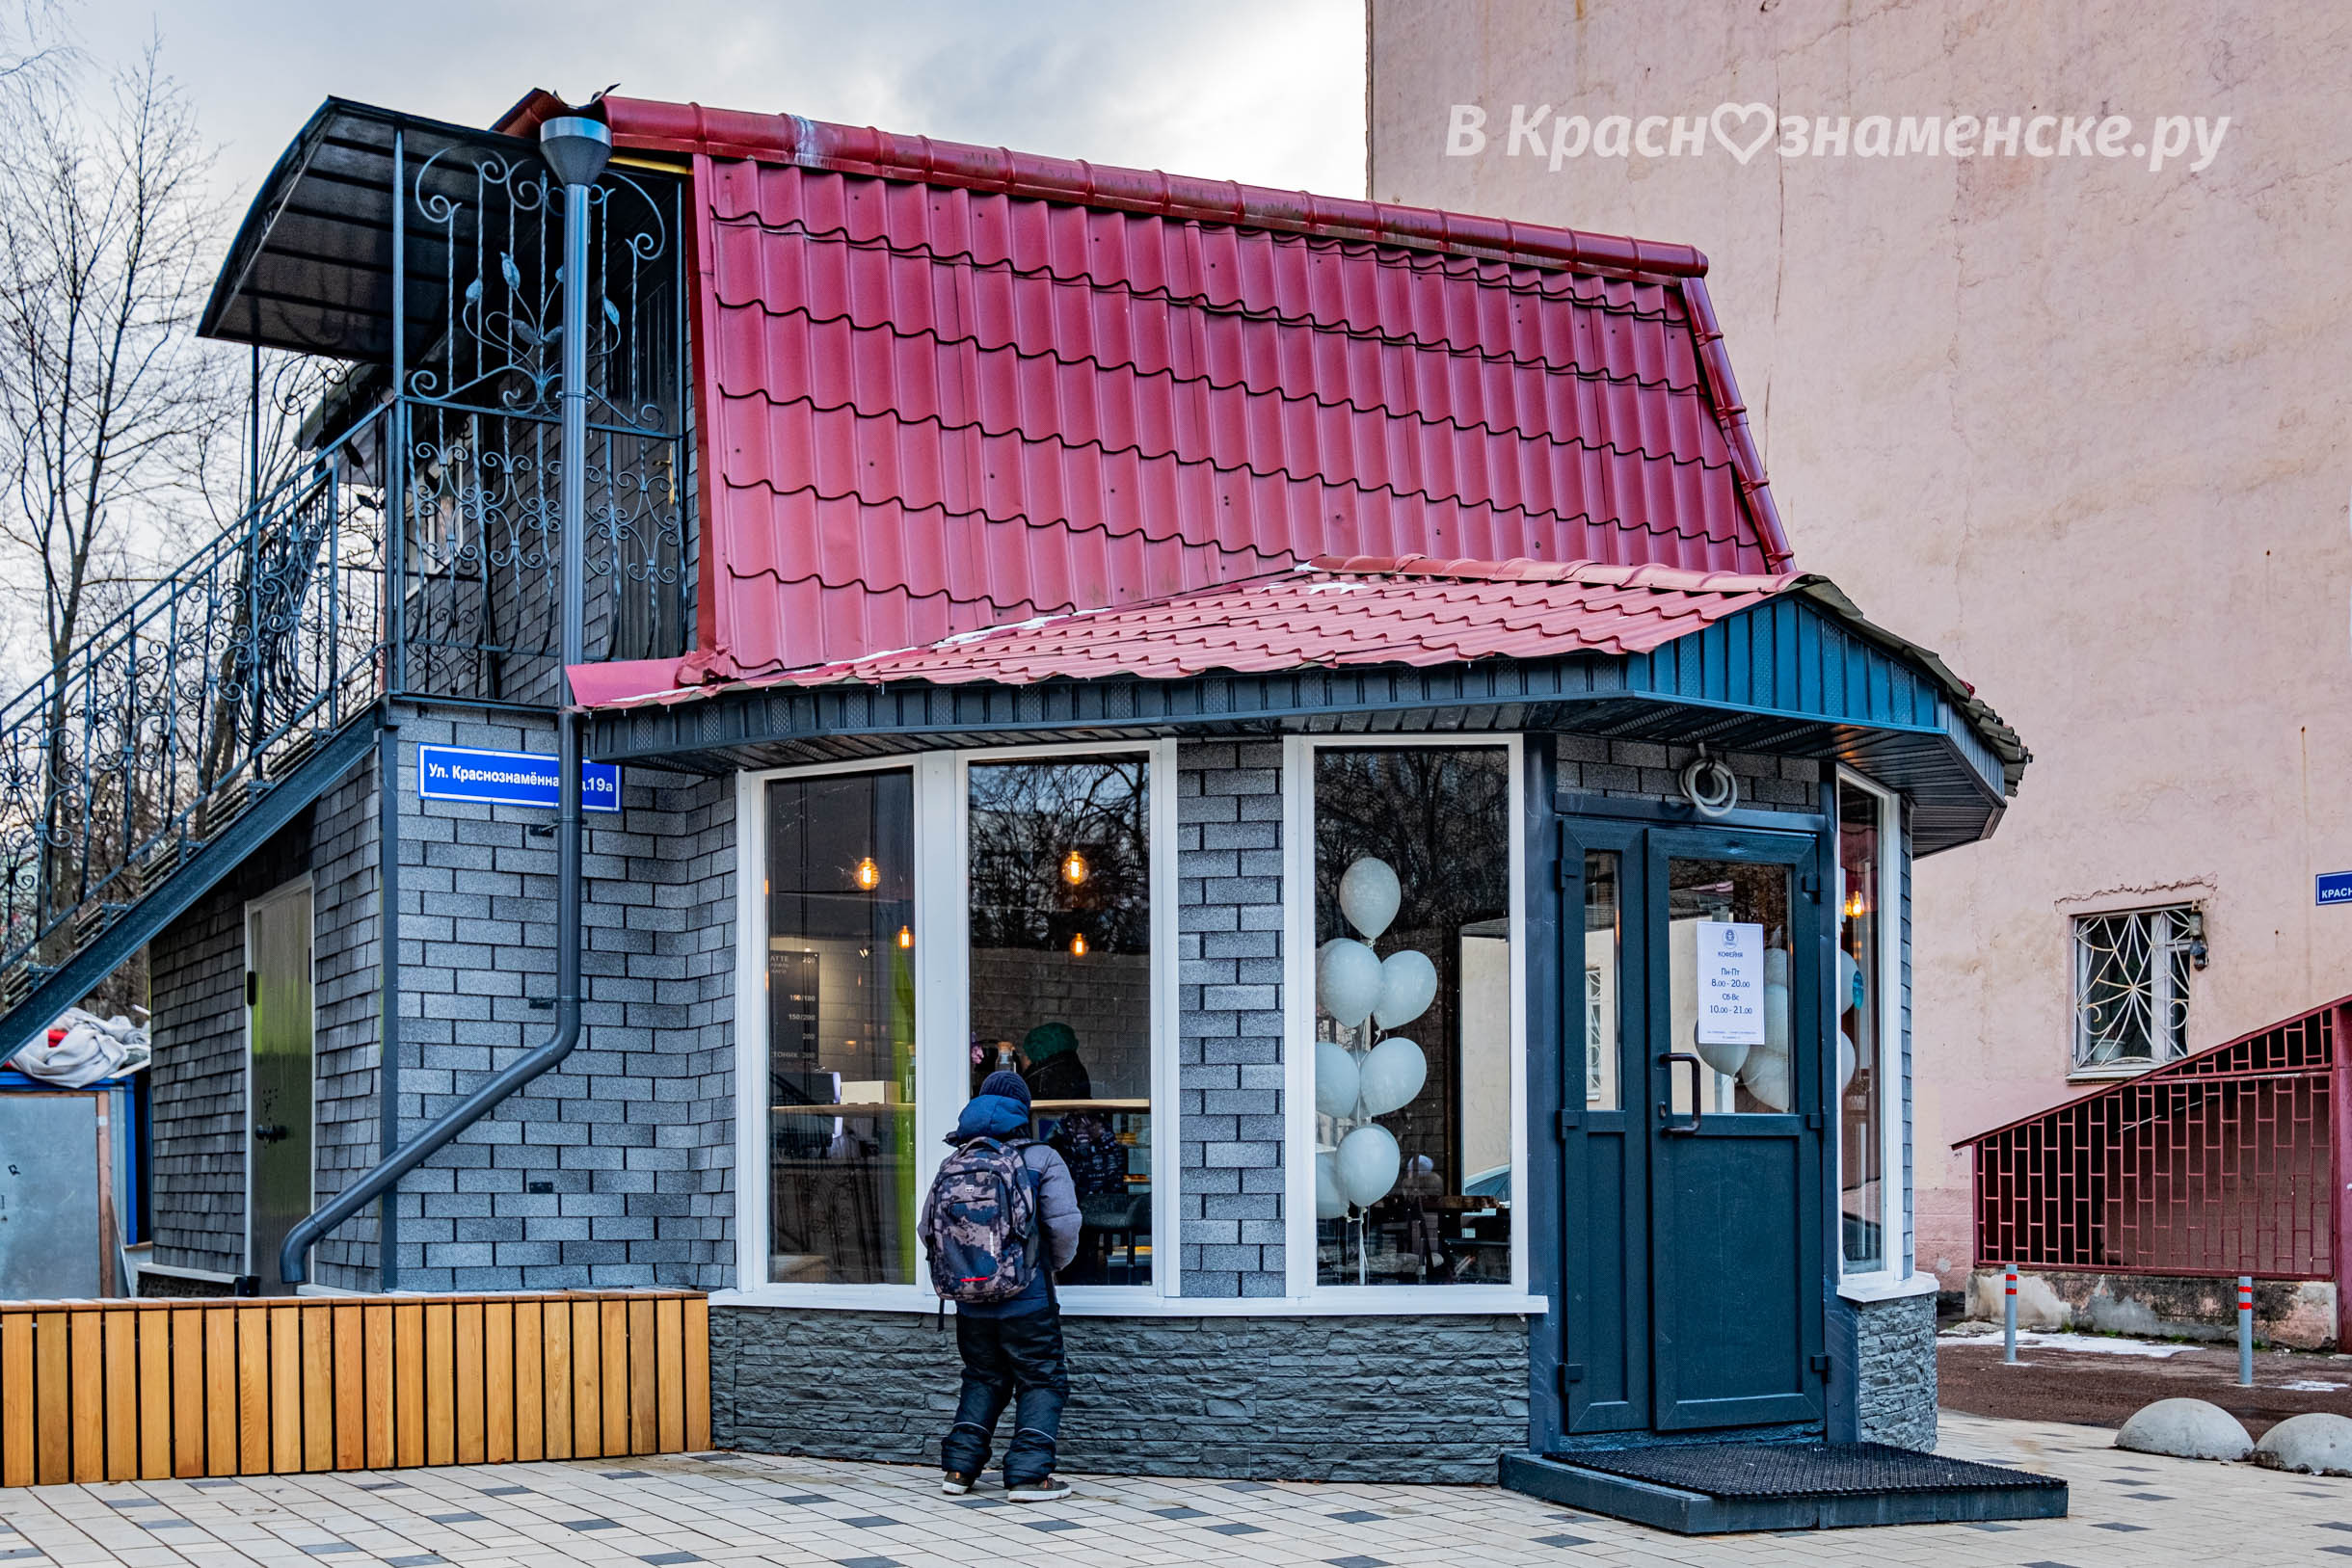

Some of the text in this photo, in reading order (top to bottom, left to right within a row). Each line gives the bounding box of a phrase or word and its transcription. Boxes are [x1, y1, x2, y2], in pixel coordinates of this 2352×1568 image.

[429, 762, 449, 779] Ул.
[452, 764, 559, 787] Краснознамённа
[1731, 979, 1751, 988] 20.00
